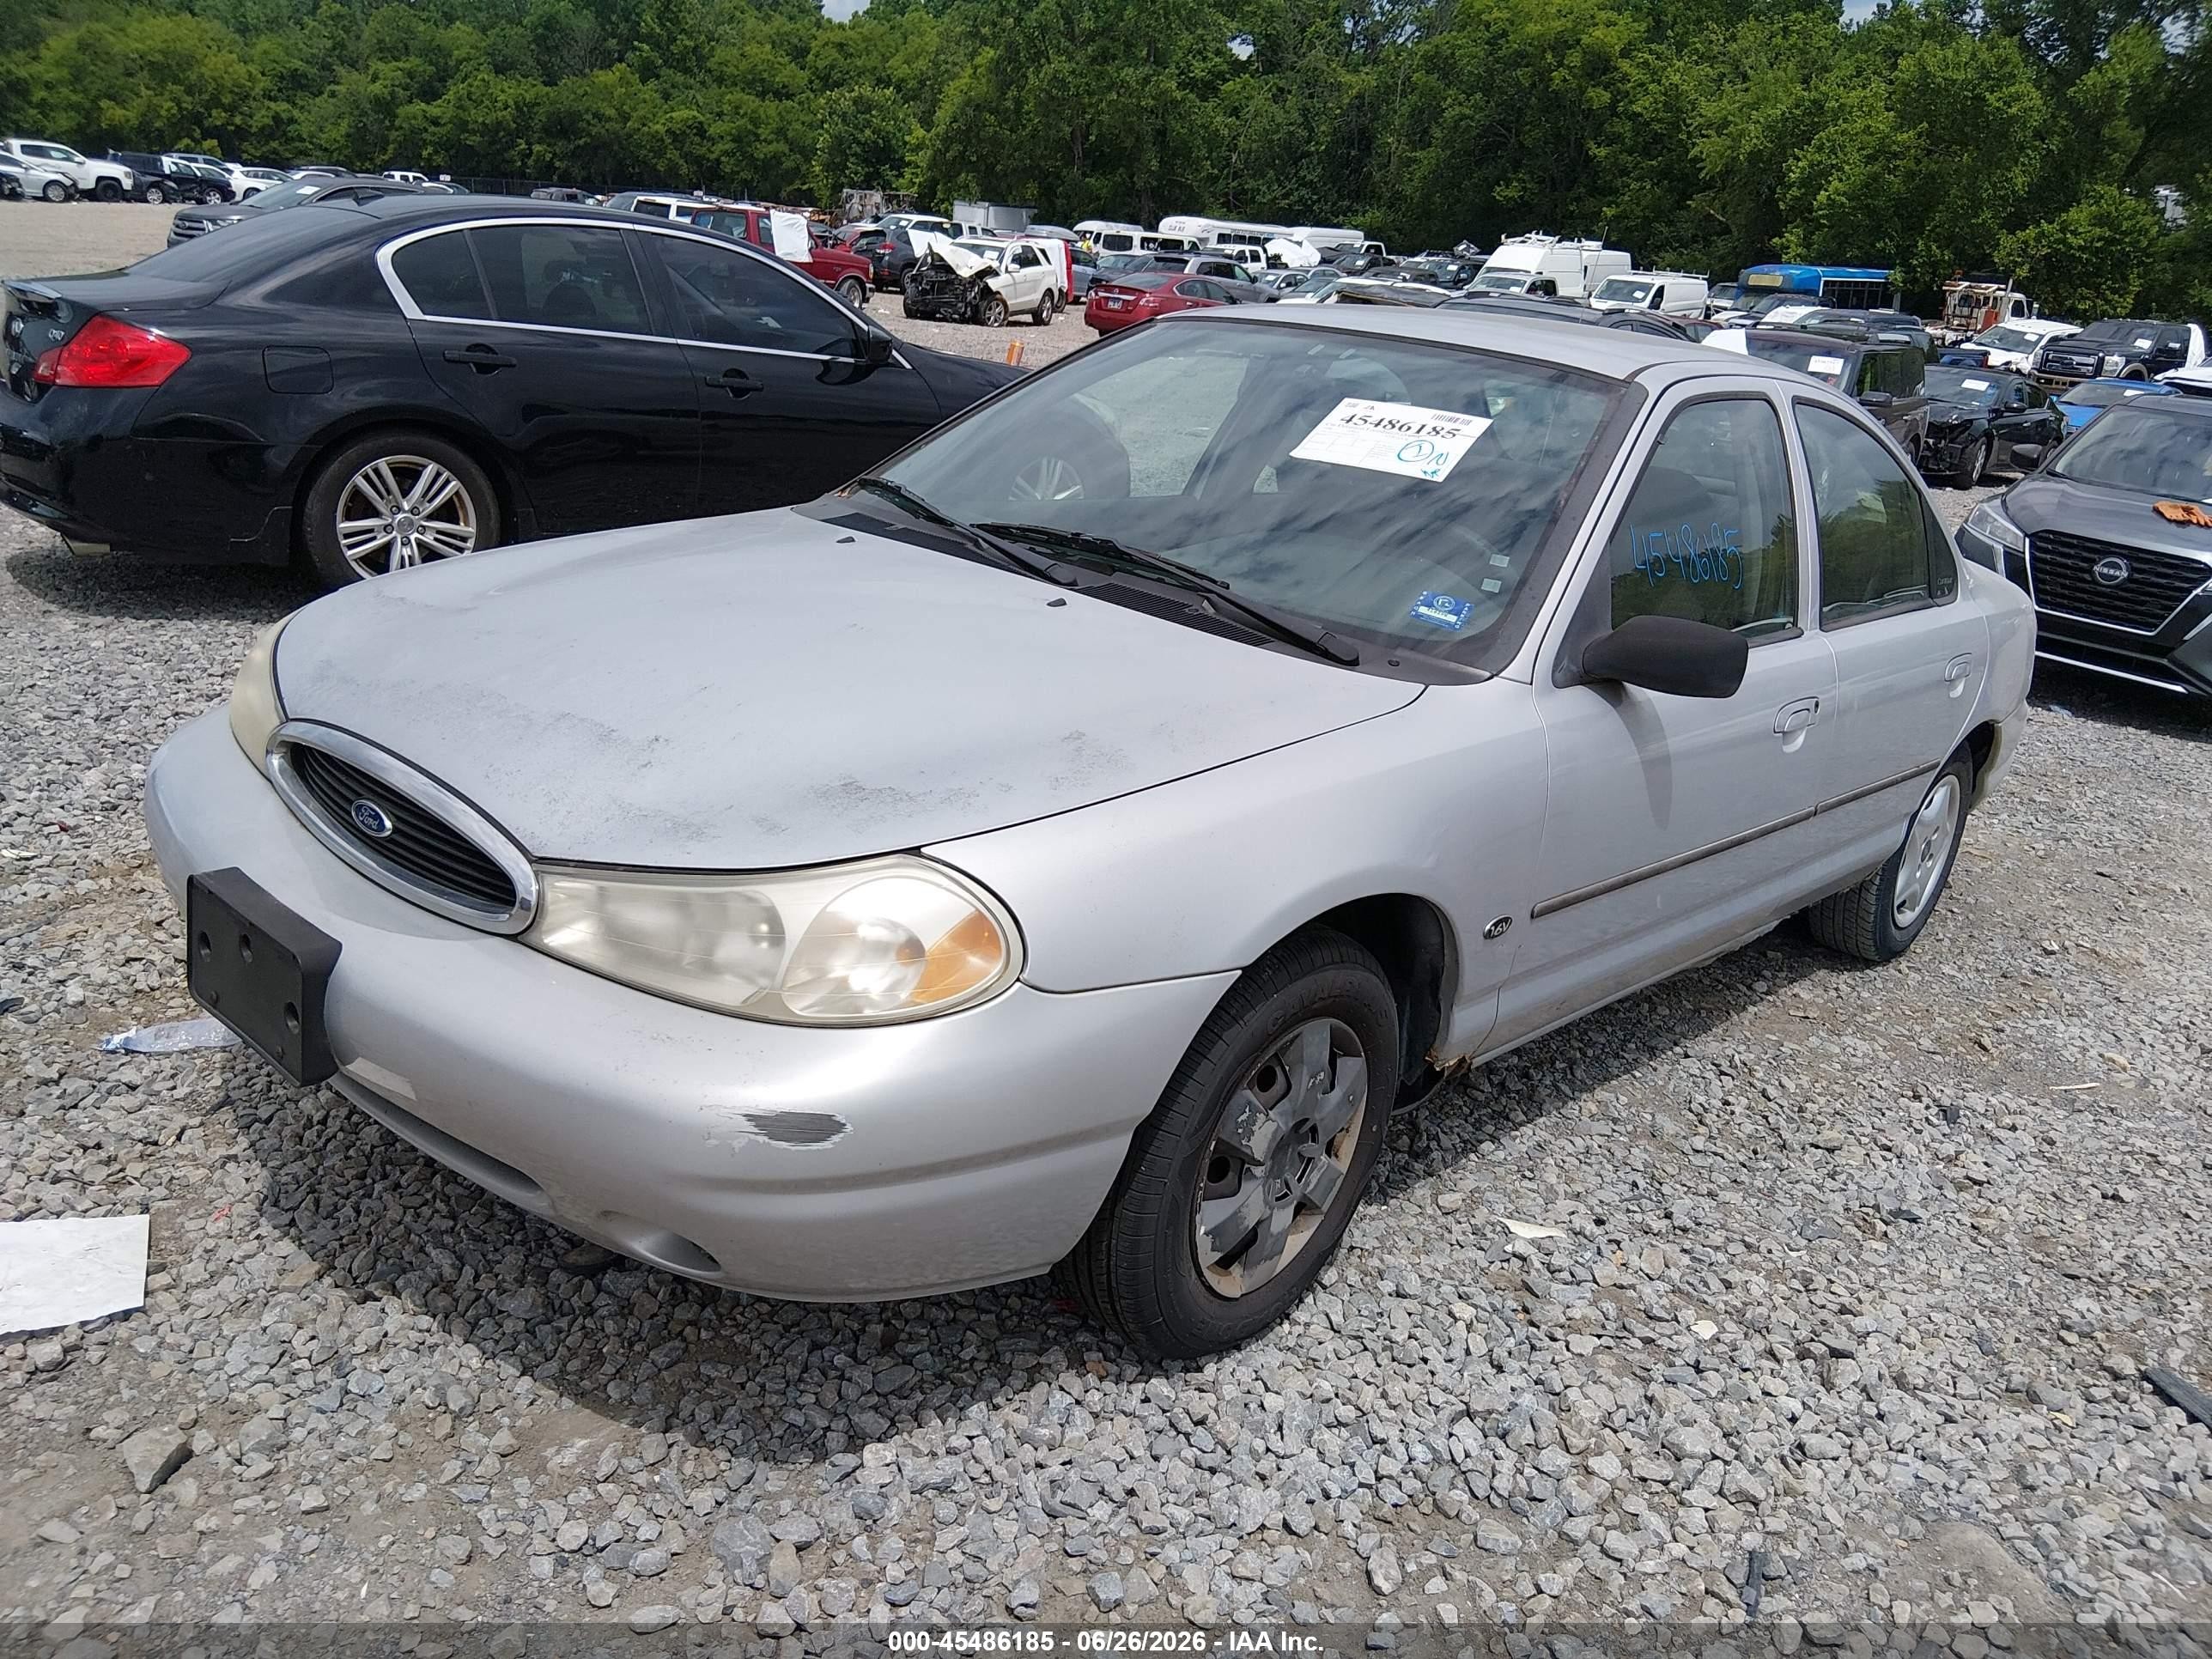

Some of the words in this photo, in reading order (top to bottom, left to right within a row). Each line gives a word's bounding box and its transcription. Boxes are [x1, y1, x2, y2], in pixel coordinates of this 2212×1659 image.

[1340, 413, 1462, 440] 45486185
[1630, 522, 1742, 589] 45486185
[2093, 565, 2129, 578] NISSAN
[358, 806, 380, 830] Ford
[1490, 919, 1511, 938] 16V
